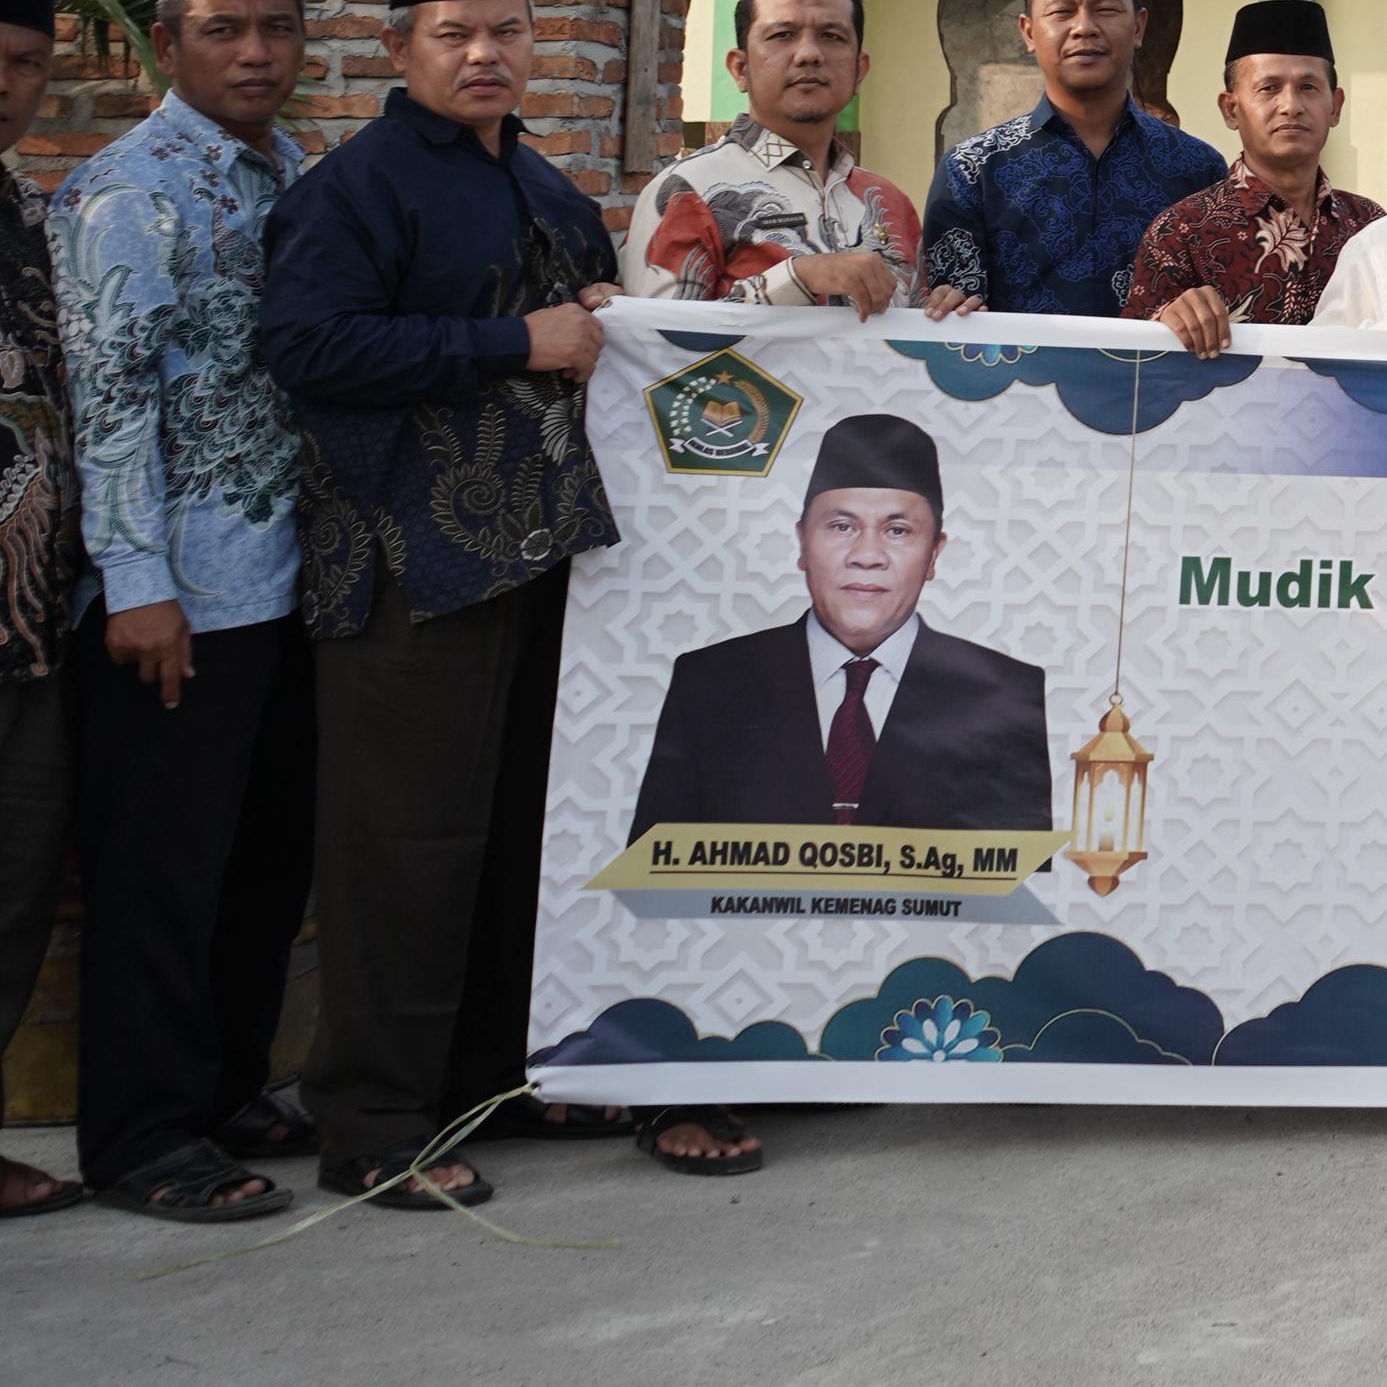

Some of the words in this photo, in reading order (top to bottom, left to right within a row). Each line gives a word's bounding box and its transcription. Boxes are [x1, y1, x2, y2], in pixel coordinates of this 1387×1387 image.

[1178, 555, 1375, 610] Mudik
[651, 840, 680, 866] H.
[687, 841, 790, 866] AHMAD
[797, 842, 891, 875] QOSBI,
[899, 845, 965, 878] S.Ag,
[972, 847, 1019, 873] MM
[710, 896, 806, 914] KAKANWIL
[810, 897, 898, 915] KEMENAG
[901, 899, 963, 917] SUMUT
